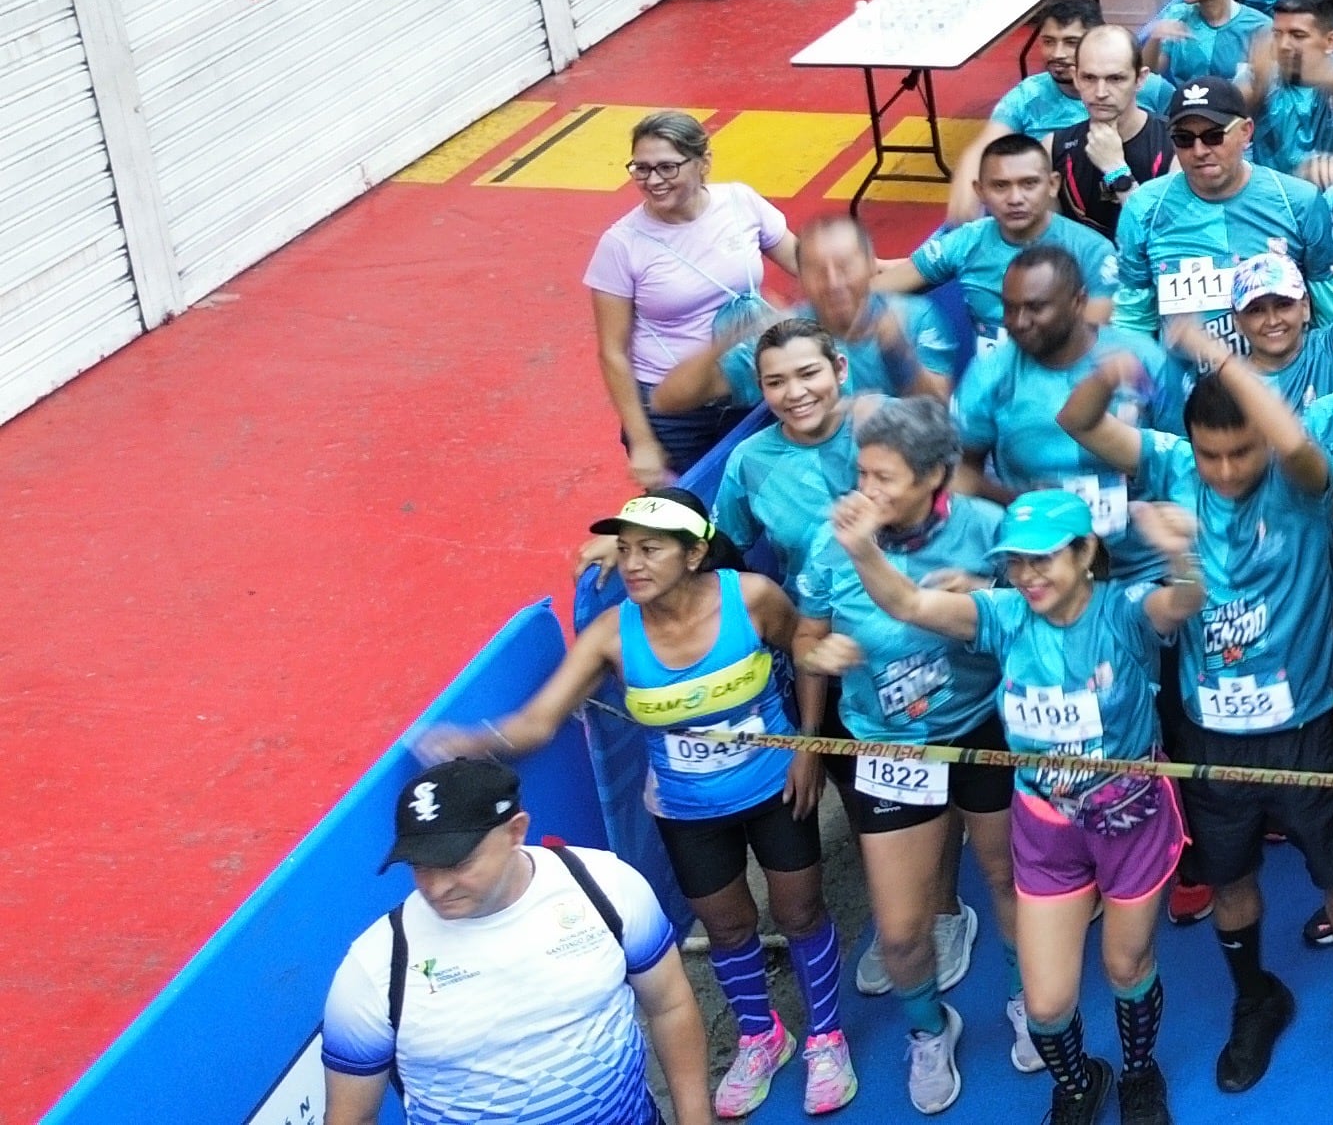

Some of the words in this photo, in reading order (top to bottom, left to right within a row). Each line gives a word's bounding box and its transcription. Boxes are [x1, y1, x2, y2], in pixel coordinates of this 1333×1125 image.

[1169, 274, 1223, 298] 1111
[1205, 313, 1234, 339] RU
[1016, 702, 1080, 726] 1198
[1209, 693, 1273, 716] 1558
[678, 738, 741, 759] 094
[807, 737, 836, 754] NO
[841, 739, 927, 759] PELIGRO
[980, 752, 1028, 767] PASE
[867, 758, 929, 789] 1822
[1216, 768, 1269, 783] PASE
